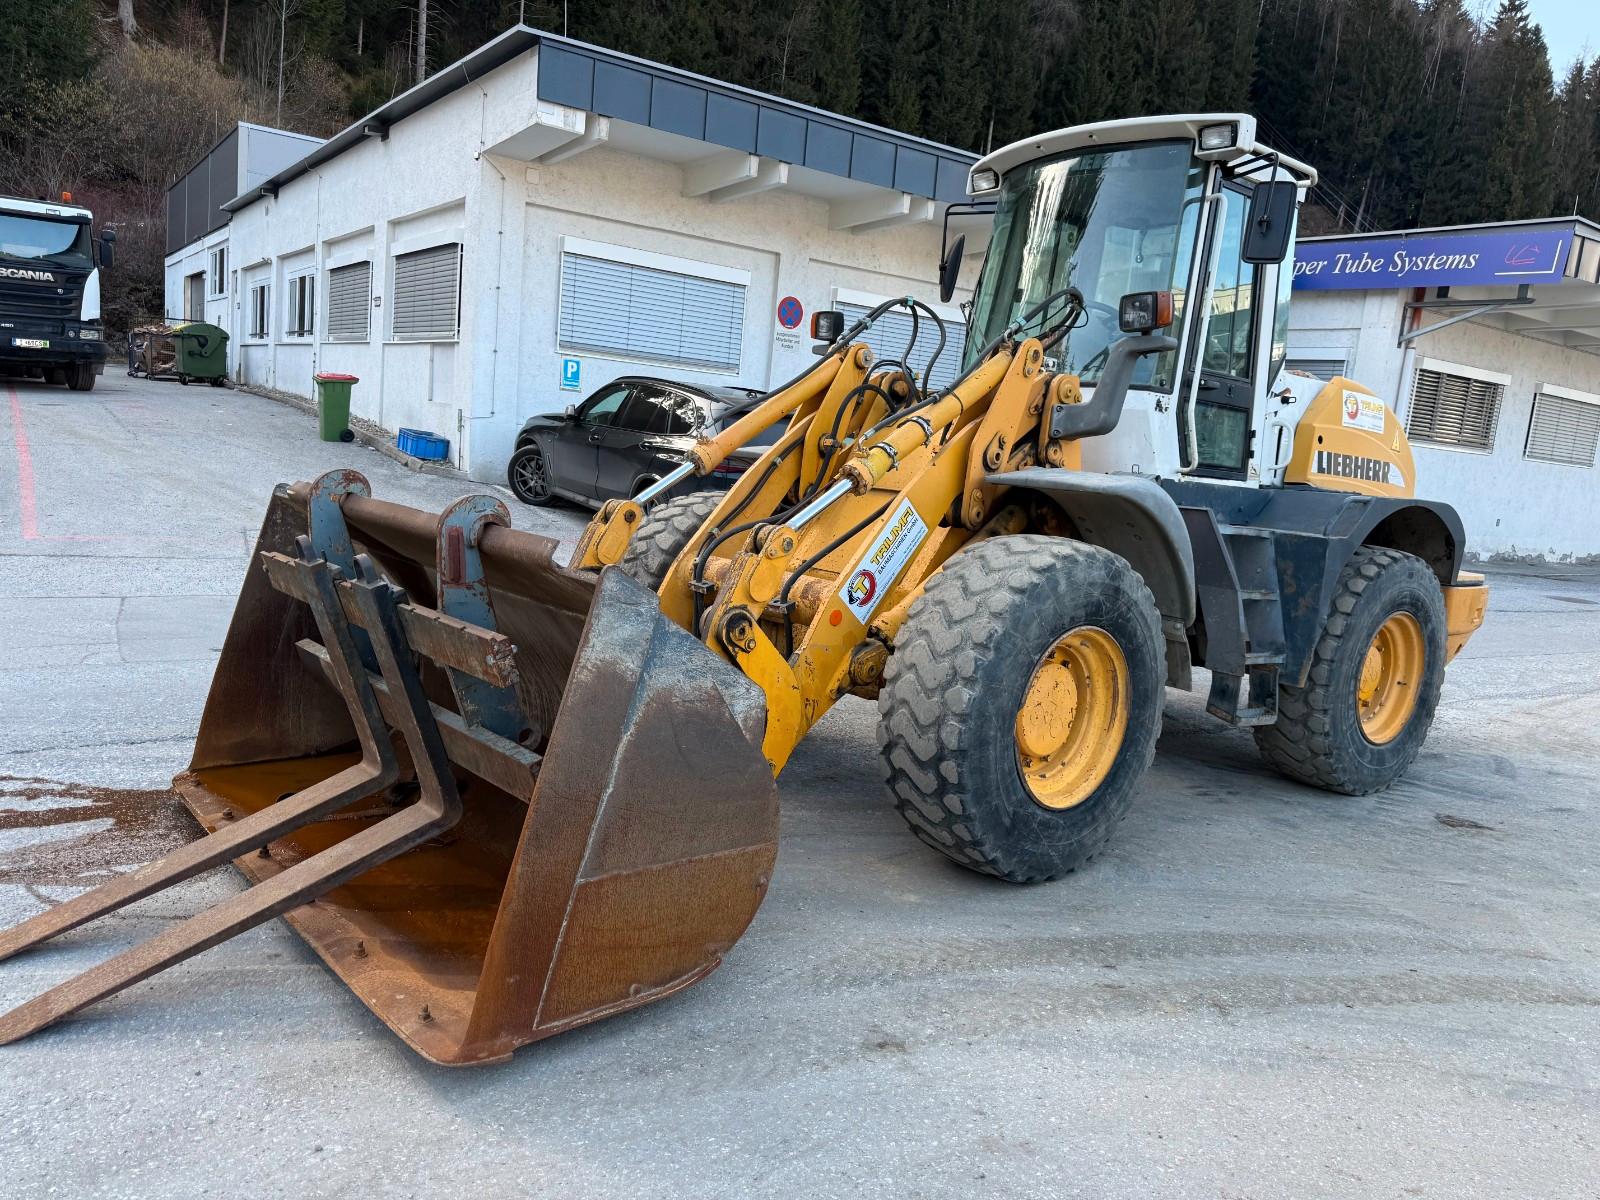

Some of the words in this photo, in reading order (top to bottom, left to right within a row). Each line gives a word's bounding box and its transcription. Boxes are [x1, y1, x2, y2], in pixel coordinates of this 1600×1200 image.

[0, 267, 55, 281] SCANIA
[1292, 257, 1328, 280] per
[1332, 252, 1384, 274] Tube
[1388, 250, 1480, 278] Systems
[567, 361, 578, 378] P
[1317, 450, 1390, 484] LIEBHERR
[871, 507, 914, 565] TRIUMFI
[878, 533, 908, 575] BAUMASCHINEN
[906, 517, 918, 533] GmbH
[852, 576, 868, 596] T
